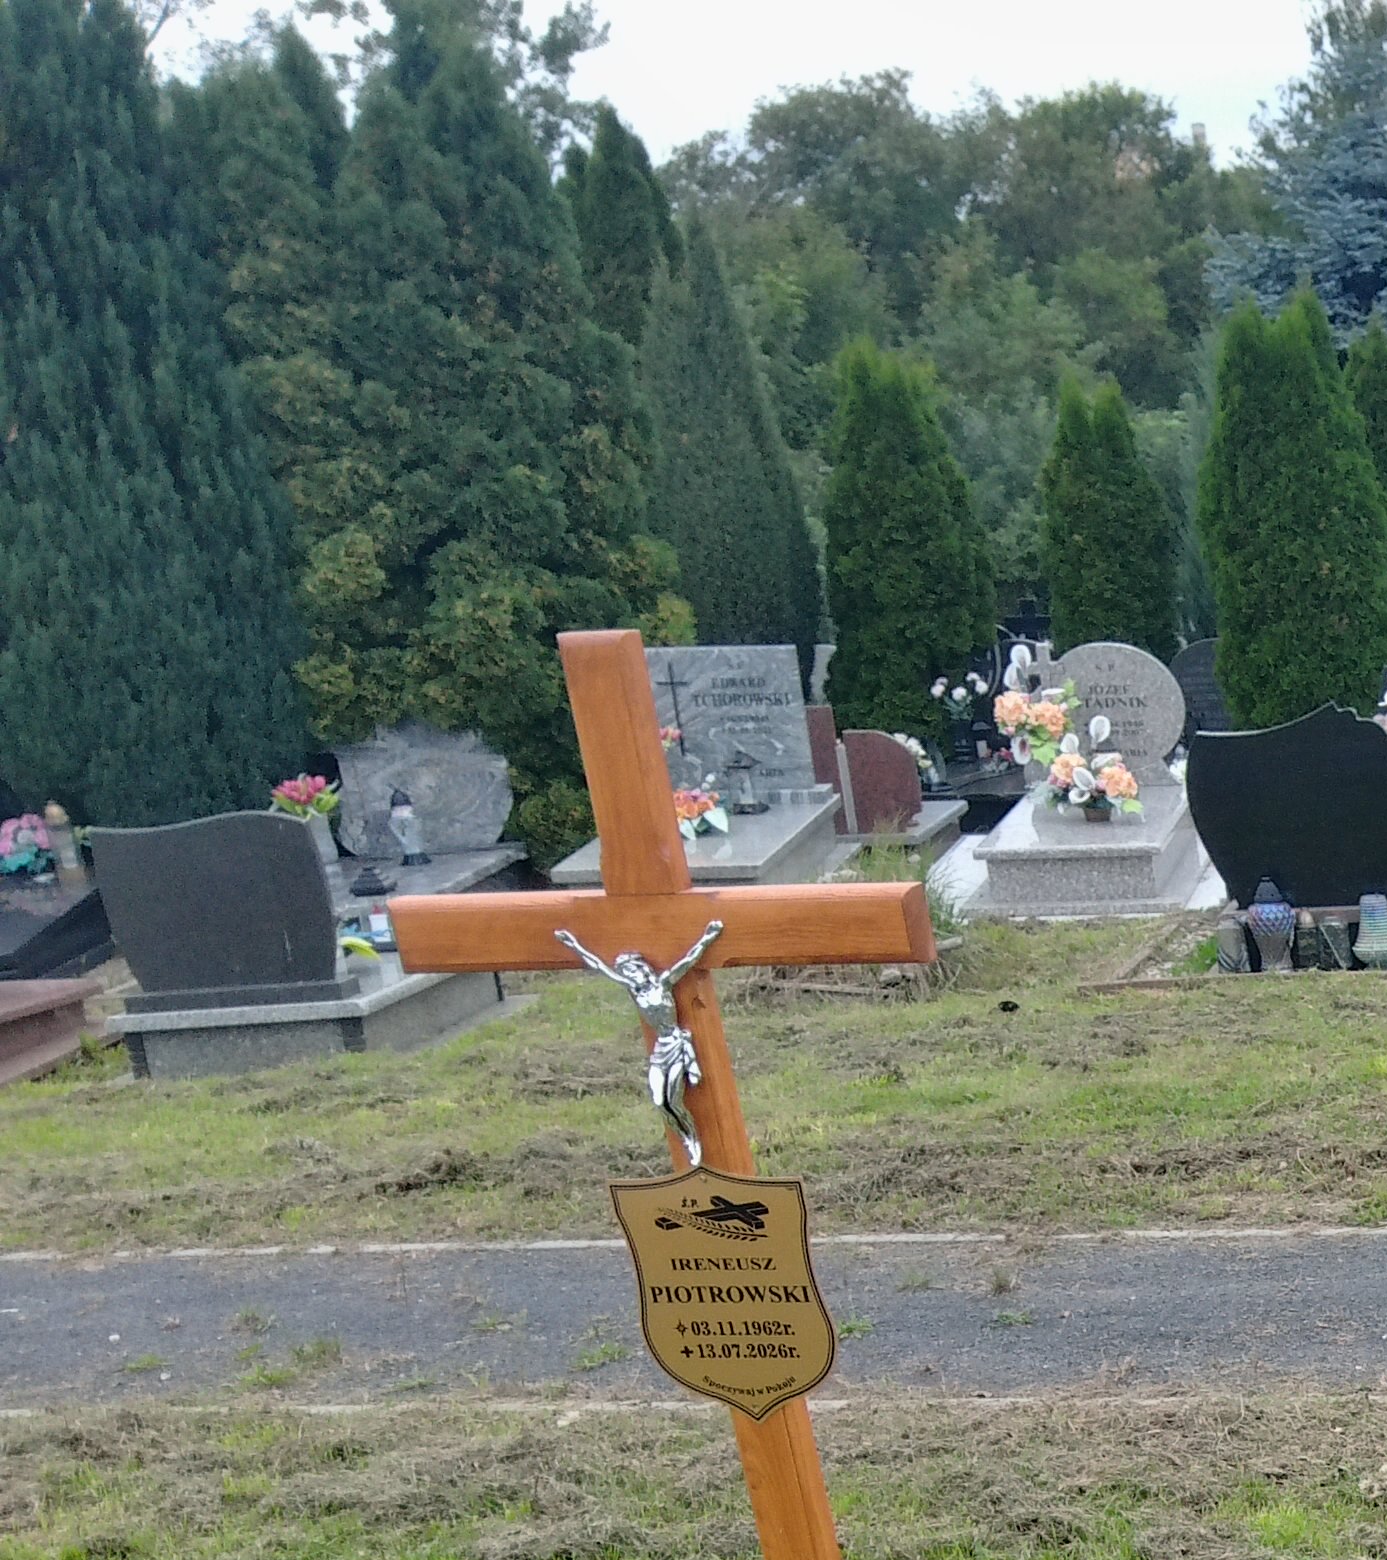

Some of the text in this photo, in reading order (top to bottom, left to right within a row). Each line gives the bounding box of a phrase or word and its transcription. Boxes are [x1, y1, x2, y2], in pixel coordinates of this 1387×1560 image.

[670, 1257, 777, 1271] IRENEUSZ
[650, 1285, 812, 1304] PIOTROWSKI
[690, 1320, 796, 1337] 03.11.1962r.
[697, 1343, 801, 1359] 13.07.2026r.
[702, 1375, 756, 1397] Spoczywaj
[765, 1375, 797, 1394] Pokoju
